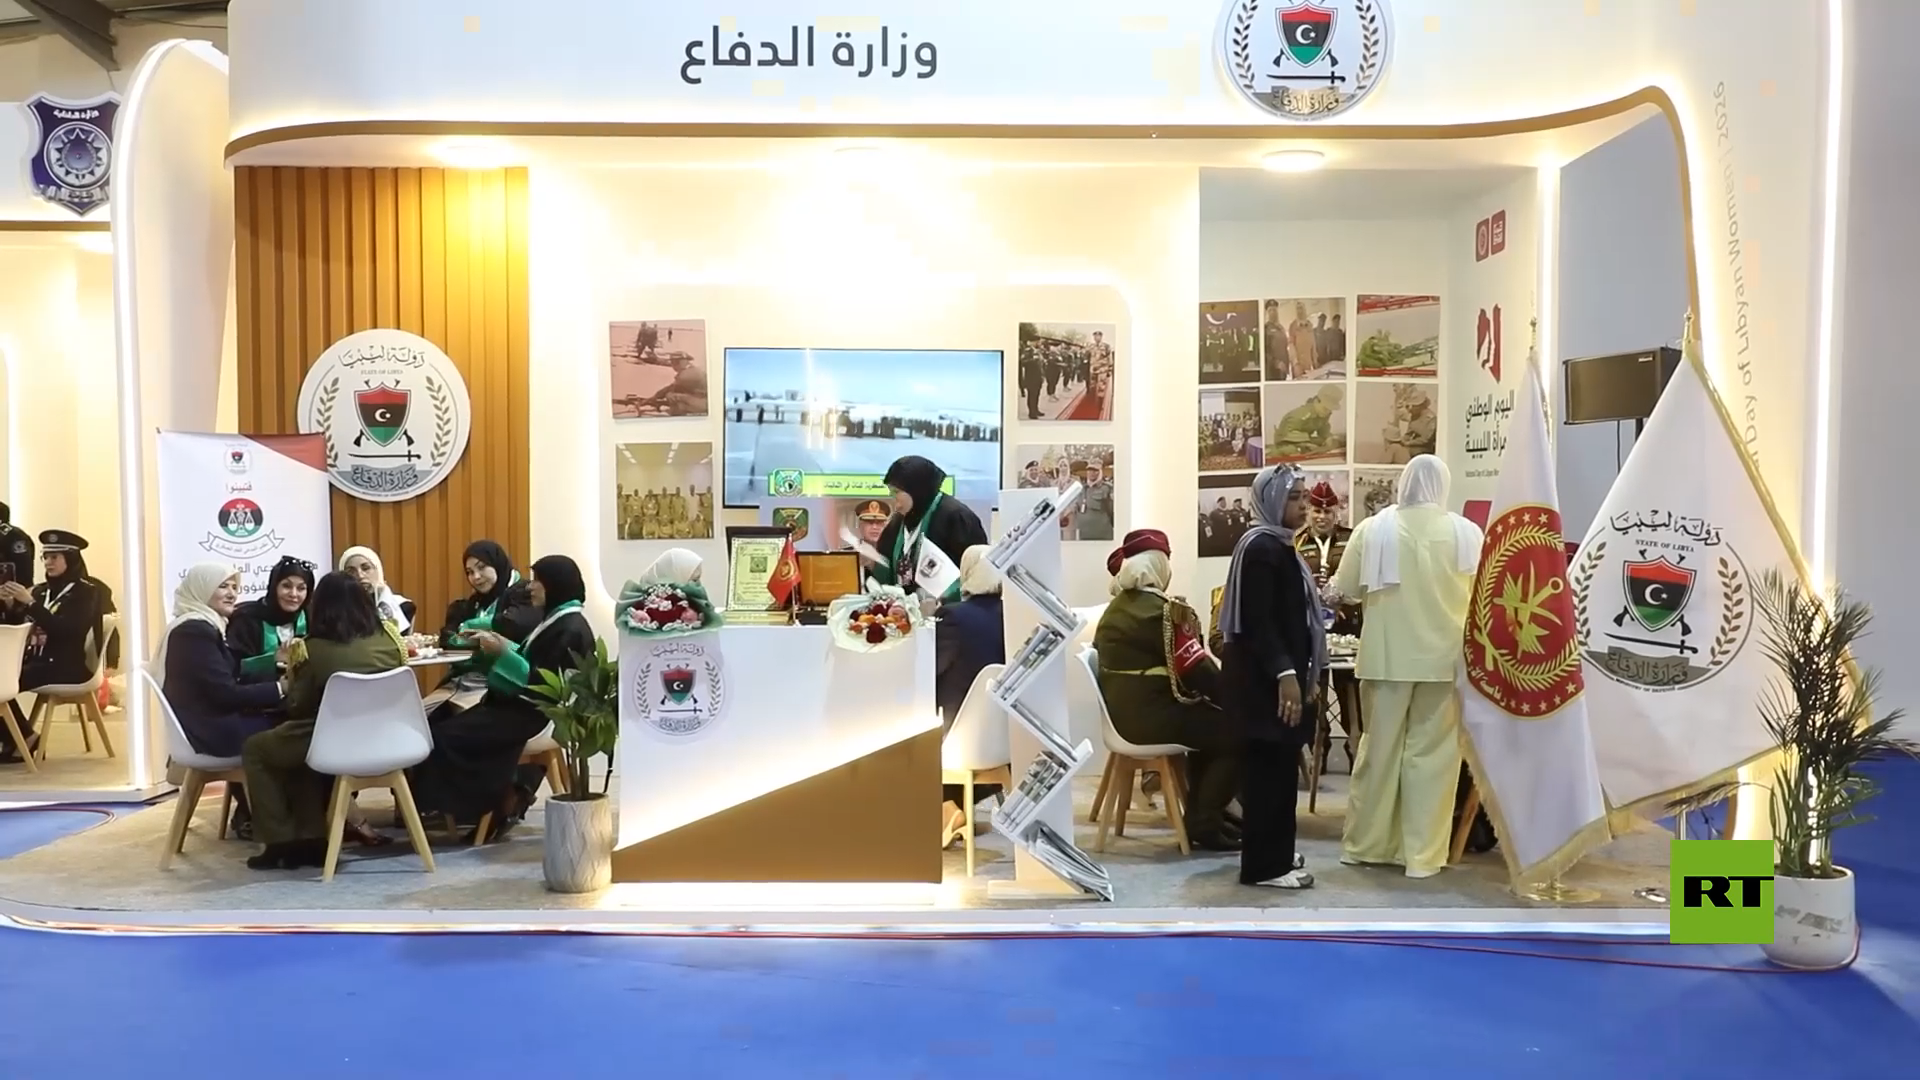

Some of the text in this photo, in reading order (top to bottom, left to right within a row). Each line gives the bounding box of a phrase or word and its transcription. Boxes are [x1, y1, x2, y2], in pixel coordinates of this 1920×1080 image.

[680, 25, 937, 84] وزارة الدفاع
[1713, 81, 1729, 147] 2026
[1723, 162, 1740, 266] Women
[1734, 266, 1749, 355] Libyan
[1738, 361, 1752, 386] of
[1465, 389, 1515, 429] اليوم الوطني
[1745, 395, 1757, 444] Day
[1465, 420, 1507, 459] مرأة الليبية
[1635, 539, 1658, 547] STATE
[1672, 543, 1694, 552] LIBYA
